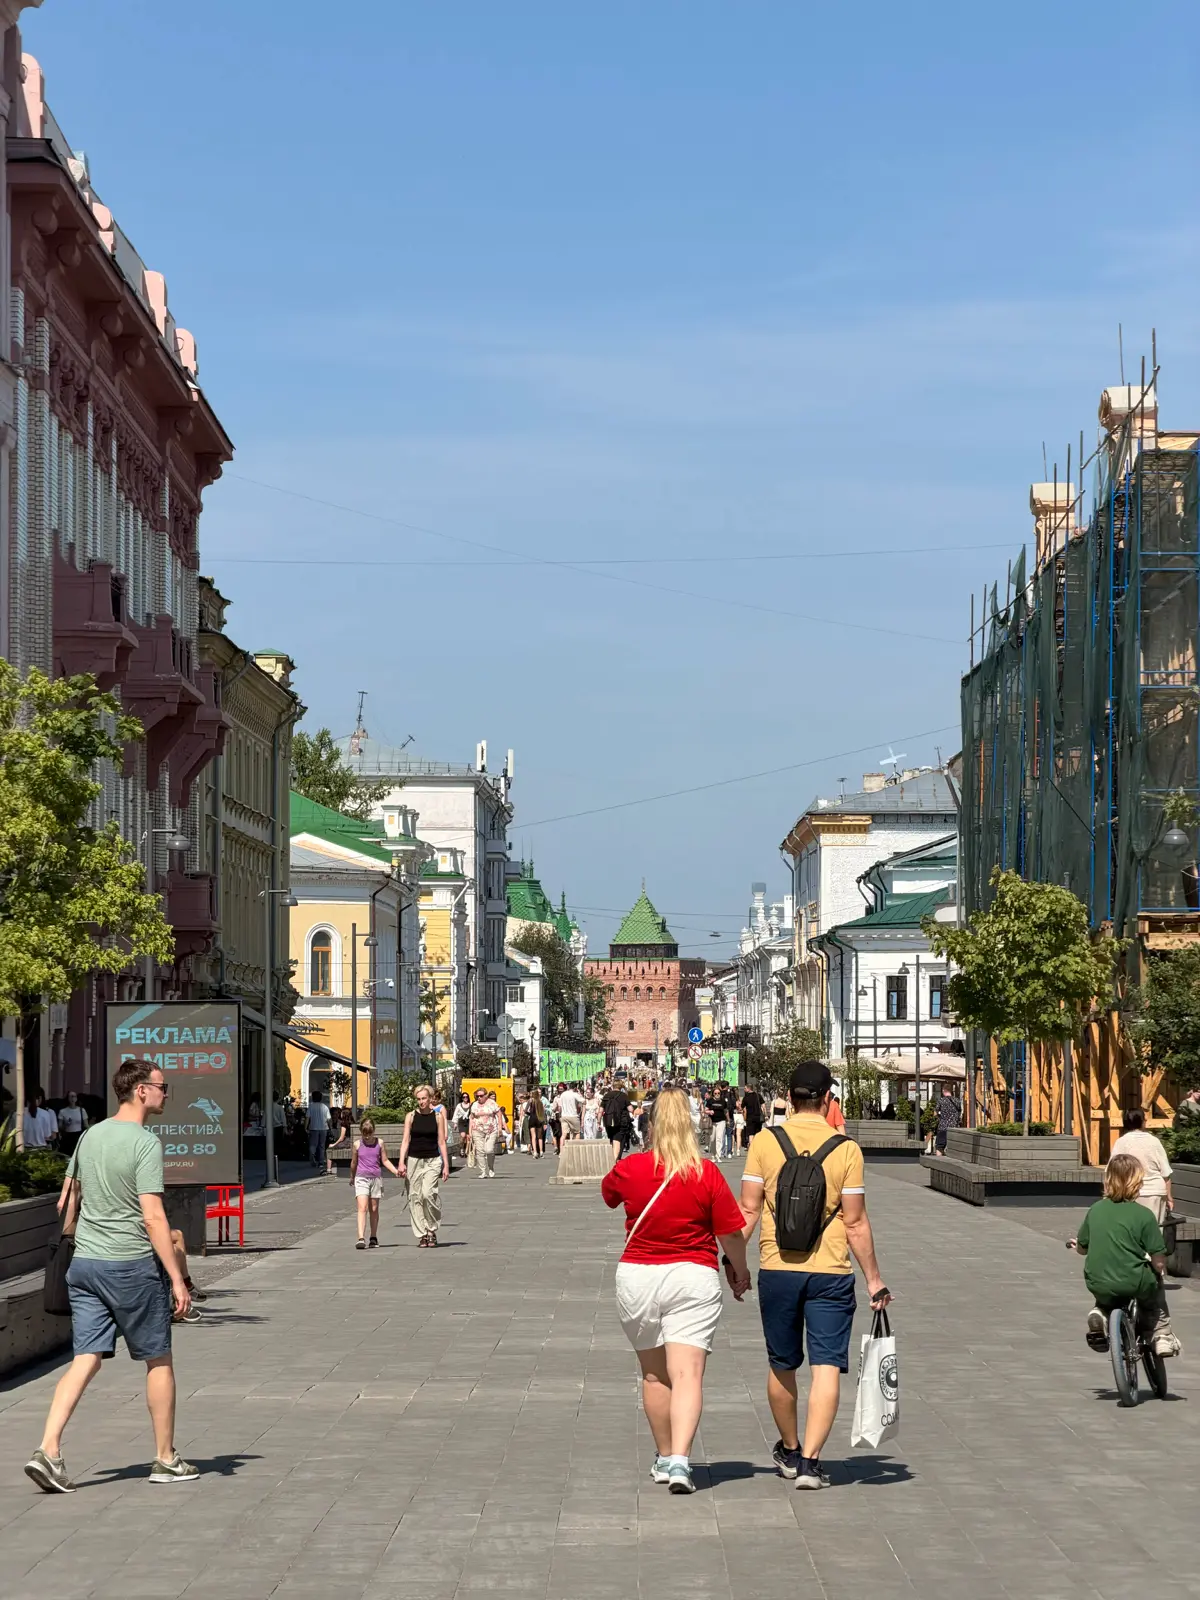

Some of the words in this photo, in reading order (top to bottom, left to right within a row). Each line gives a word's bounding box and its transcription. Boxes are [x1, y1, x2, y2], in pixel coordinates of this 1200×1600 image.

[116, 1027, 232, 1044] РЕКЛАМА
[143, 1052, 226, 1069] МЕТРО
[164, 1143, 188, 1155] 20
[192, 1143, 216, 1155] 80
